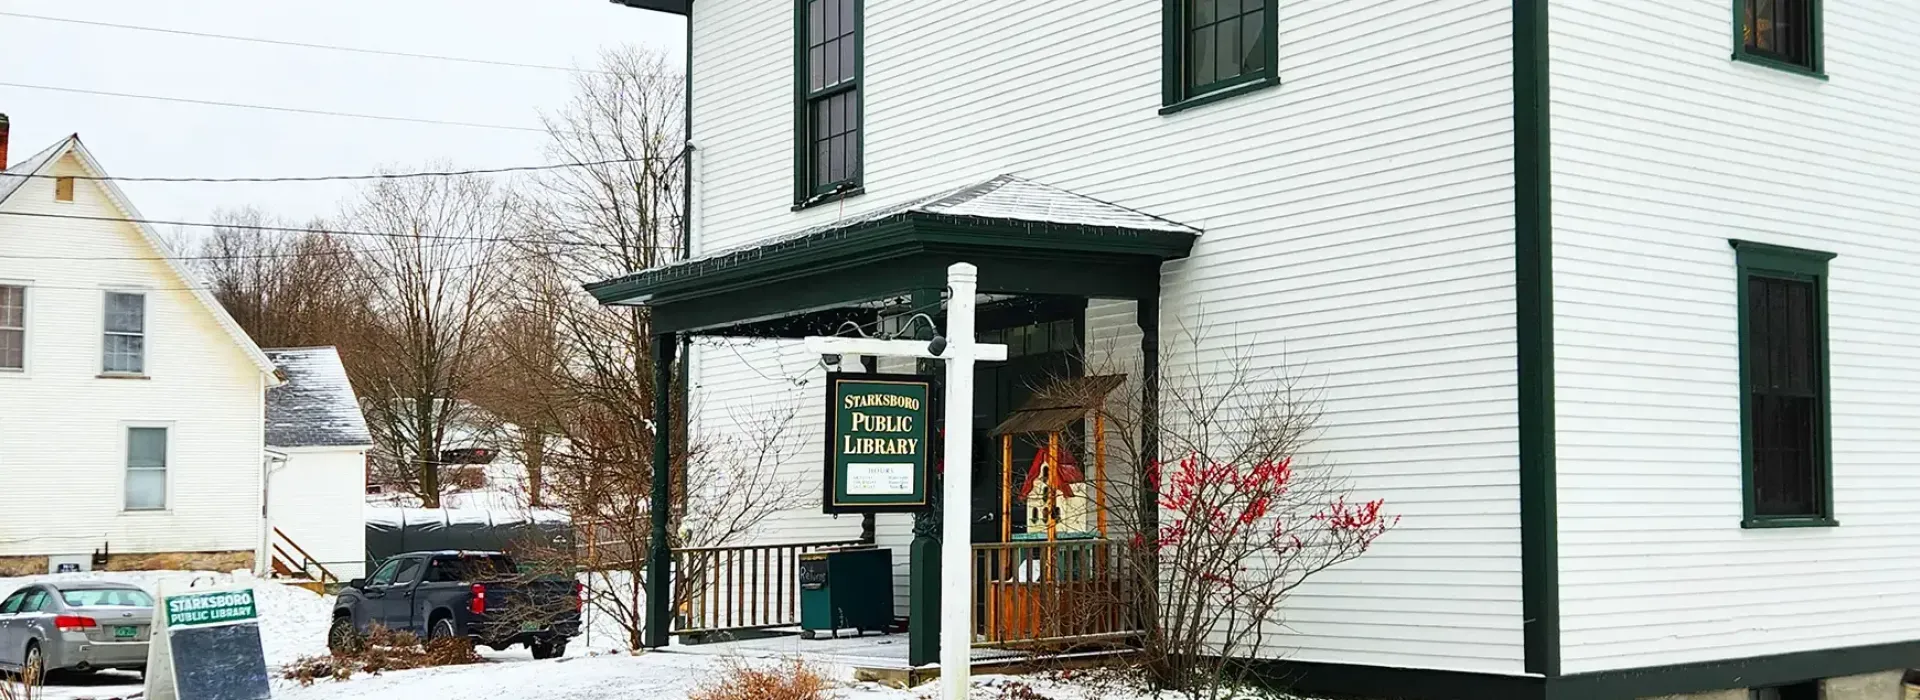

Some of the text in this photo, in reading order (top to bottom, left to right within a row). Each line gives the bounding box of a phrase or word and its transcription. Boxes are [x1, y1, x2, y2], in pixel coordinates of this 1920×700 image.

[844, 394, 920, 410] STARKSBORO
[851, 412, 913, 432] PUBLIC
[843, 435, 918, 454] LIBRARY
[169, 593, 251, 612] STARKSBORO
[171, 606, 252, 623] PUBLIC LIBRARY
